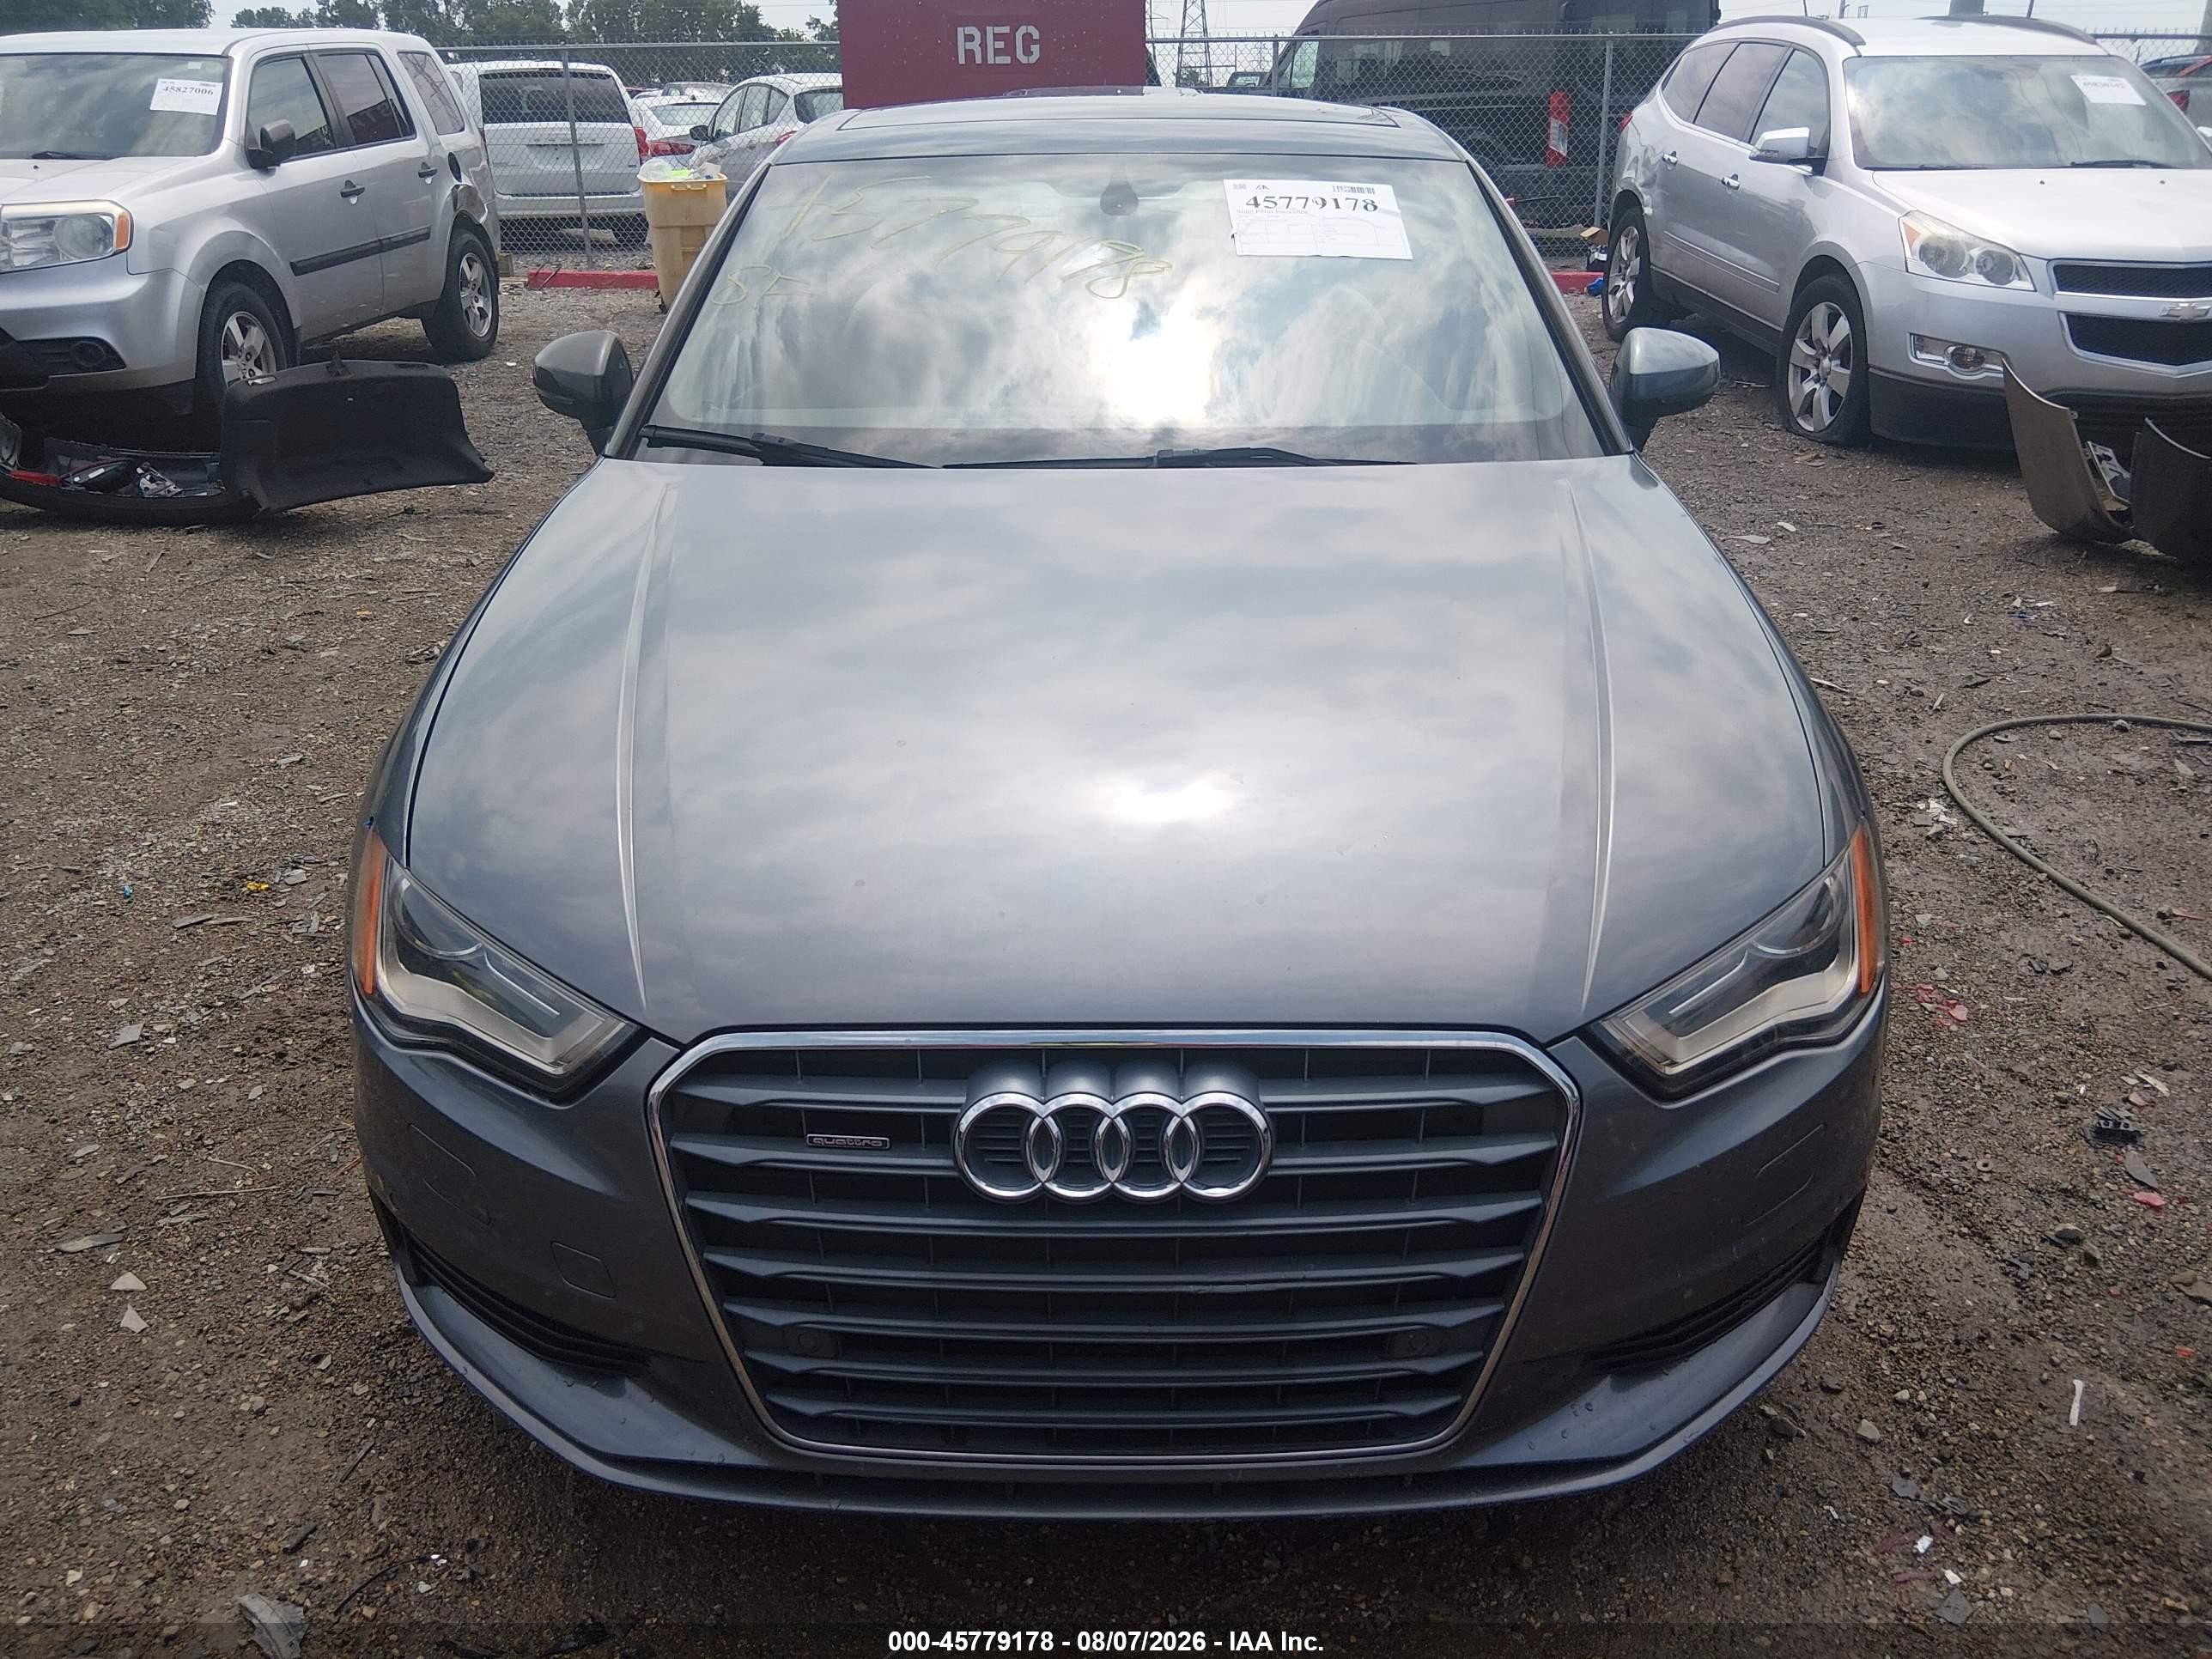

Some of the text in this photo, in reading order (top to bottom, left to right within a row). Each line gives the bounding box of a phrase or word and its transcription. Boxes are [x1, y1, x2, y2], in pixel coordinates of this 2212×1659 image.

[957, 25, 1040, 64] REG
[162, 86, 214, 96] 45827006
[1245, 196, 1378, 212] 45779178
[812, 1137, 883, 1146] quattro
